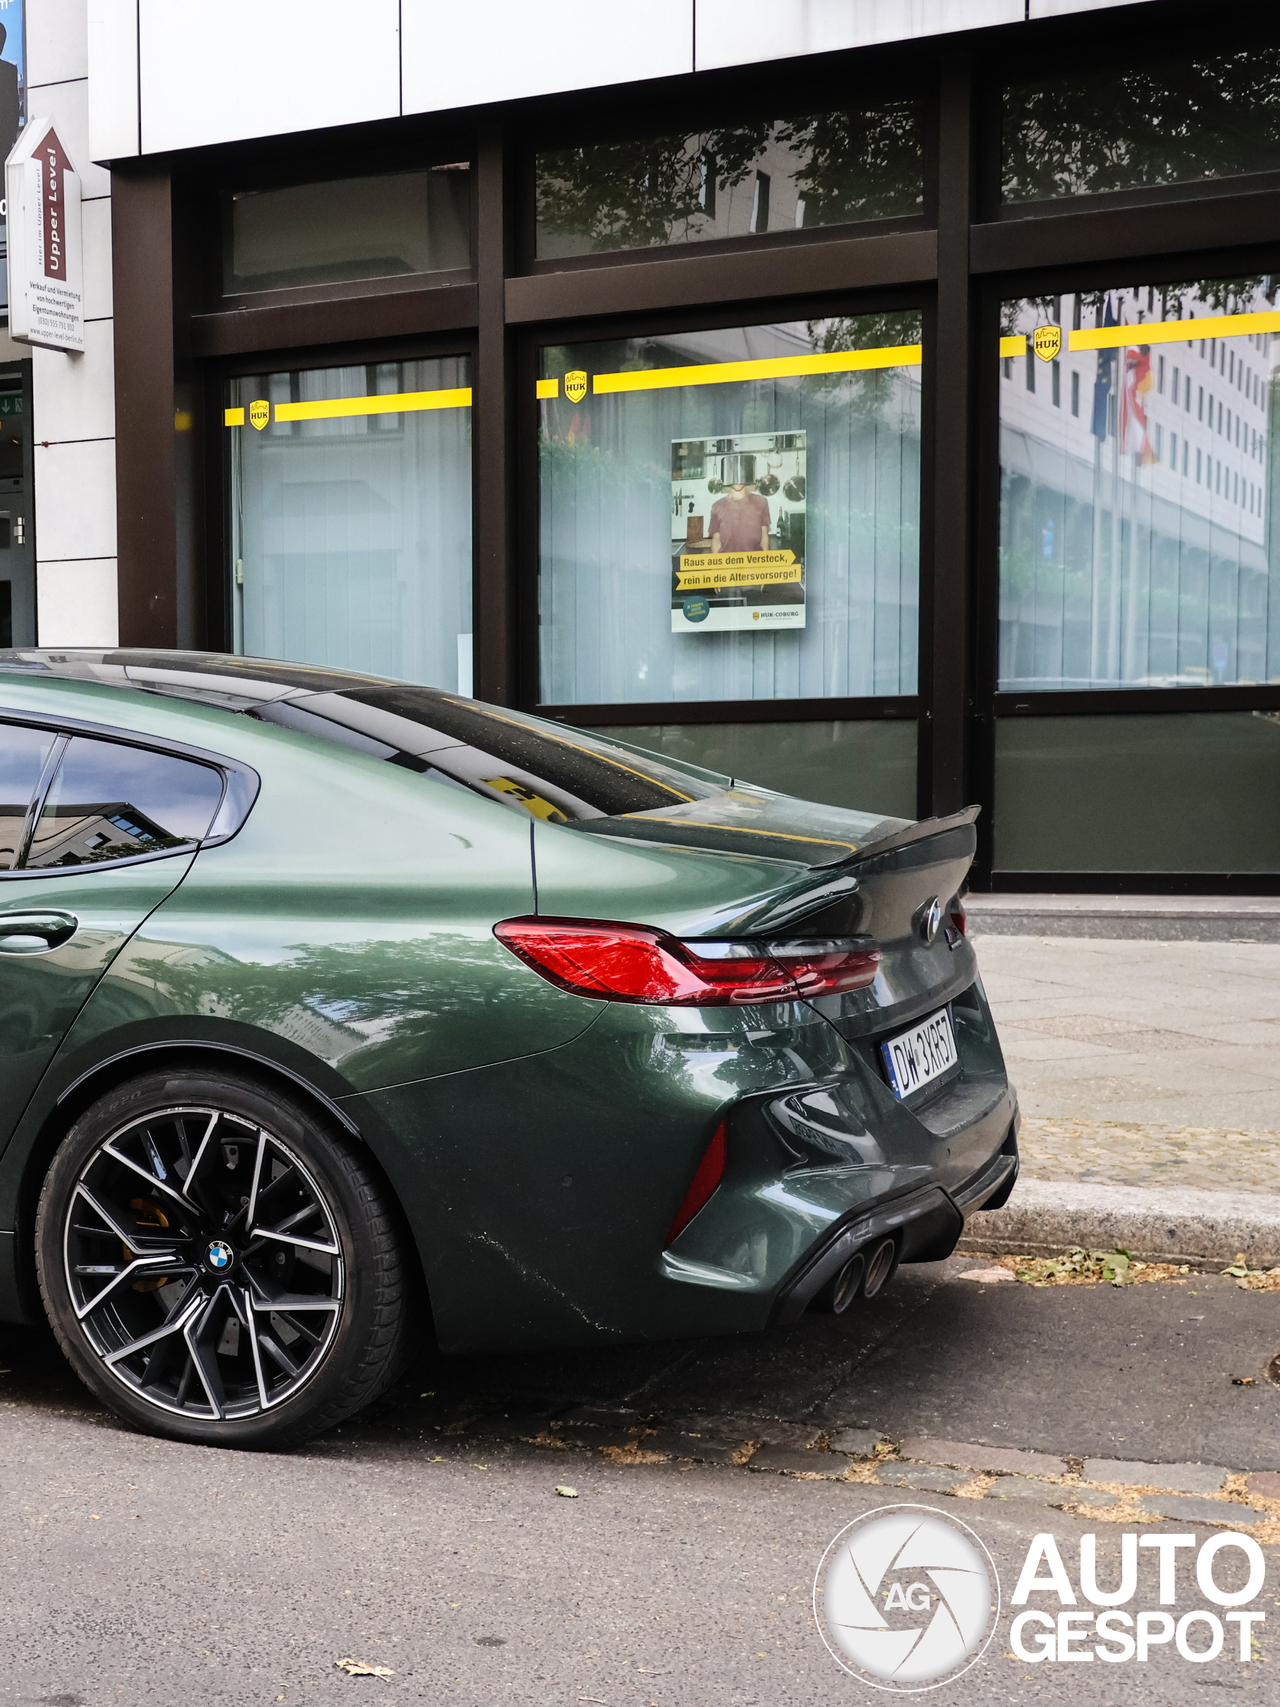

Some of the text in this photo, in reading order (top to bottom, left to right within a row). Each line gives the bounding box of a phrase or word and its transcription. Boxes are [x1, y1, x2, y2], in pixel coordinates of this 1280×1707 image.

[47, 148, 61, 271] Upper Level
[29, 280, 81, 302] Verkauf und Vermietung
[45, 295, 75, 310] hochwertigen
[49, 319, 58, 328] 555
[58, 320, 67, 330] 751
[66, 322, 75, 332] 302
[1035, 340, 1059, 349] HUK
[566, 383, 586, 391] HUK
[251, 411, 268, 419] HUK
[683, 553, 788, 567] Raus aus dem Versteck,
[683, 569, 797, 585] rein in die Altersvorsorge!
[893, 1015, 954, 1091] DW 3XR57
